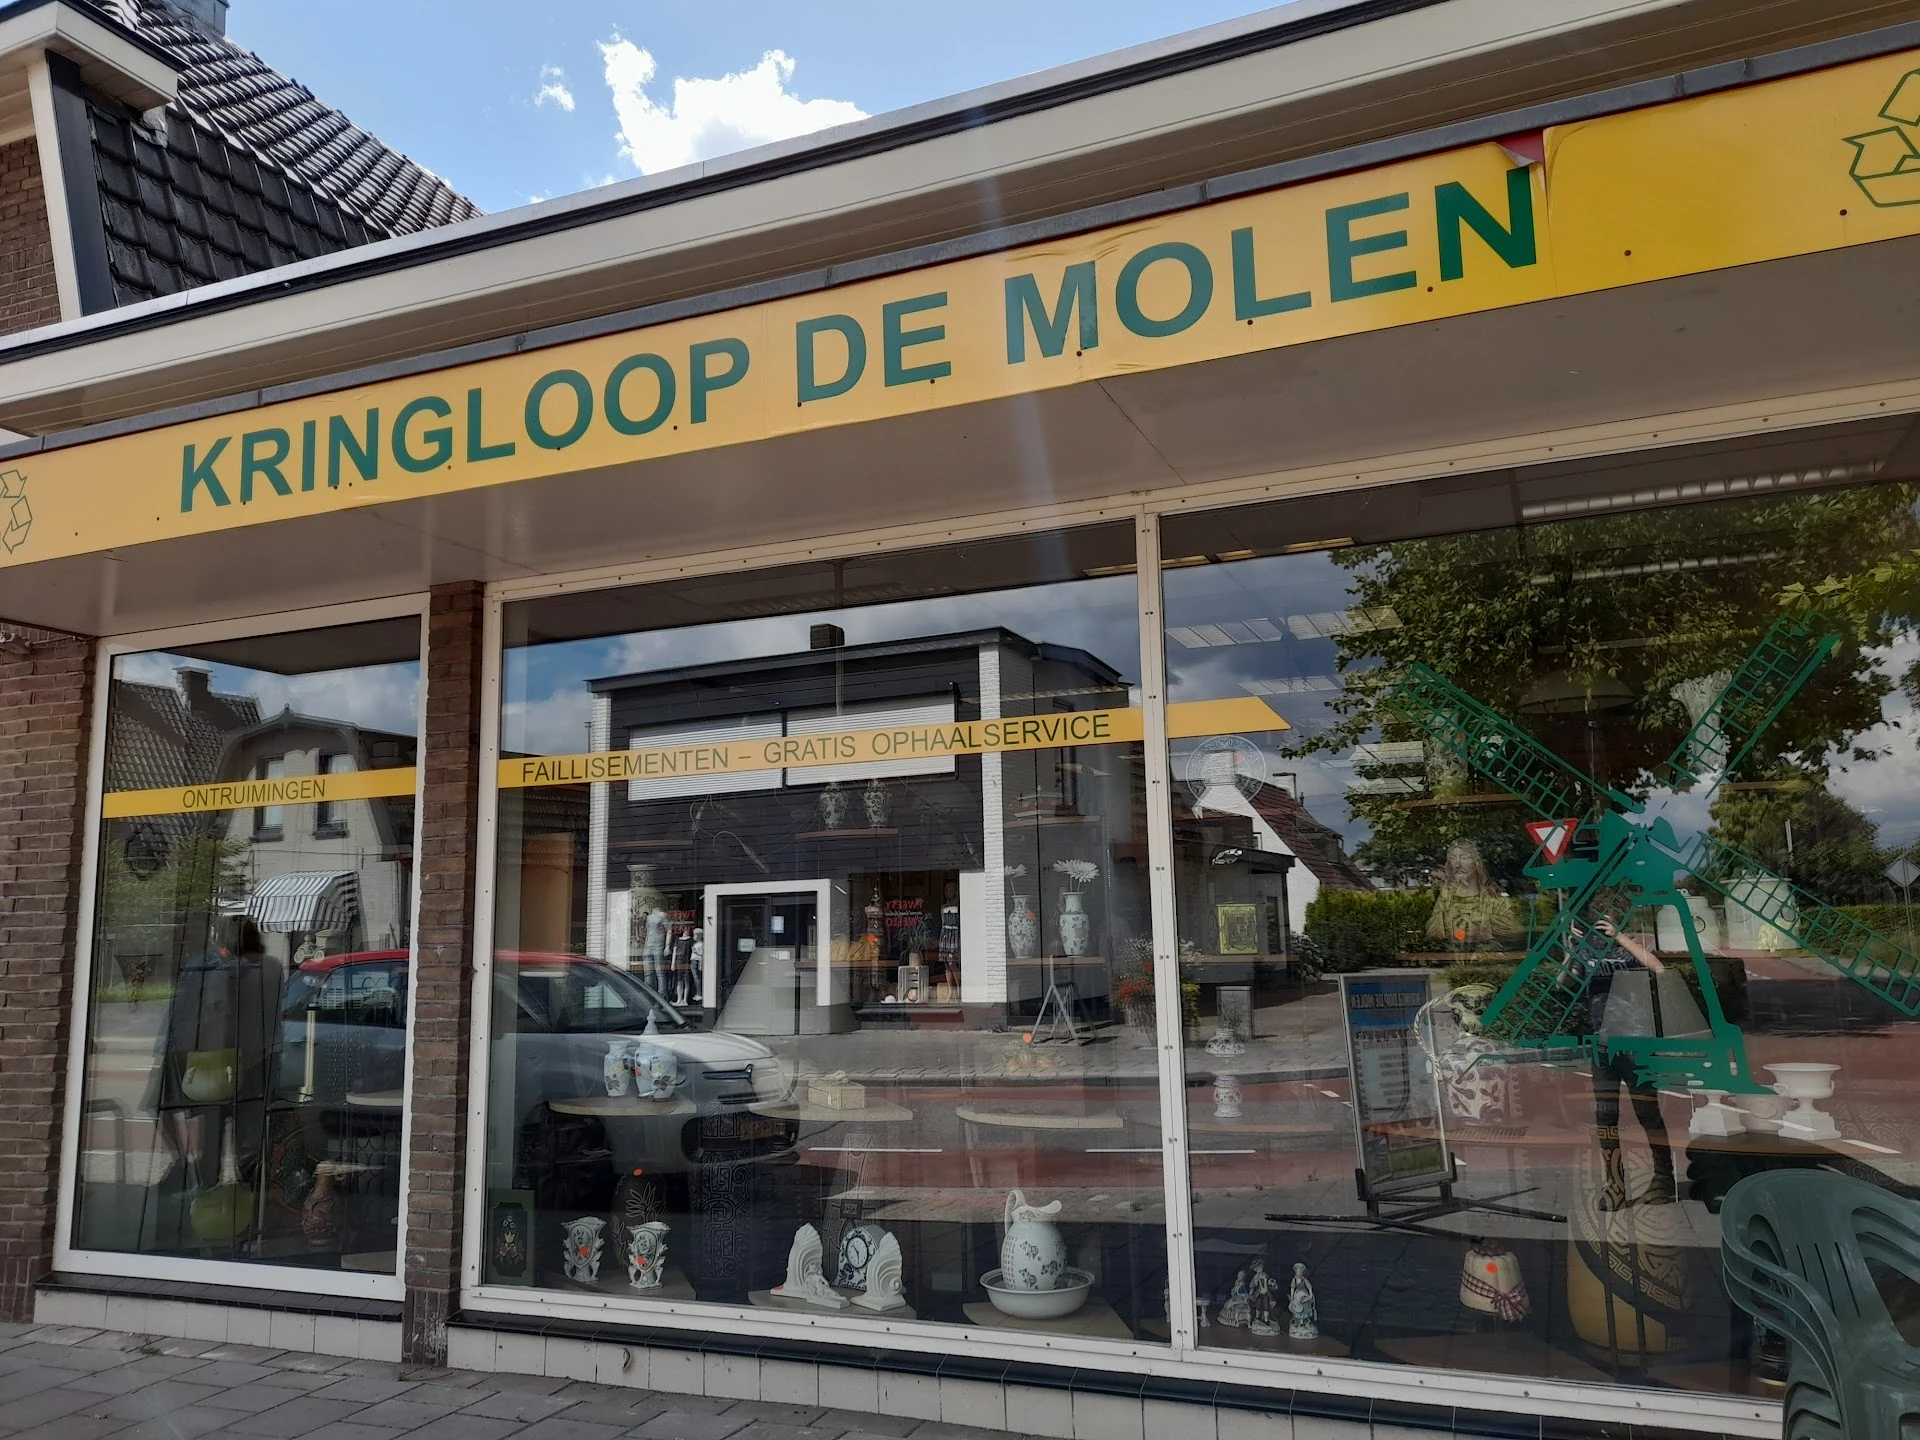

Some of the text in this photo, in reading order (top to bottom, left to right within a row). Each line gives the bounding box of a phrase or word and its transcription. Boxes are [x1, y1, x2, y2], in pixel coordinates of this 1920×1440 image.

[182, 168, 1536, 513] KRINGLOOP DE MOLEN
[522, 747, 729, 783] FAILLISEMENTEN
[763, 735, 857, 765] GRATIS
[871, 713, 1111, 756] OPHAALSERVICE
[182, 776, 327, 809] ONTRUIMINGEN
